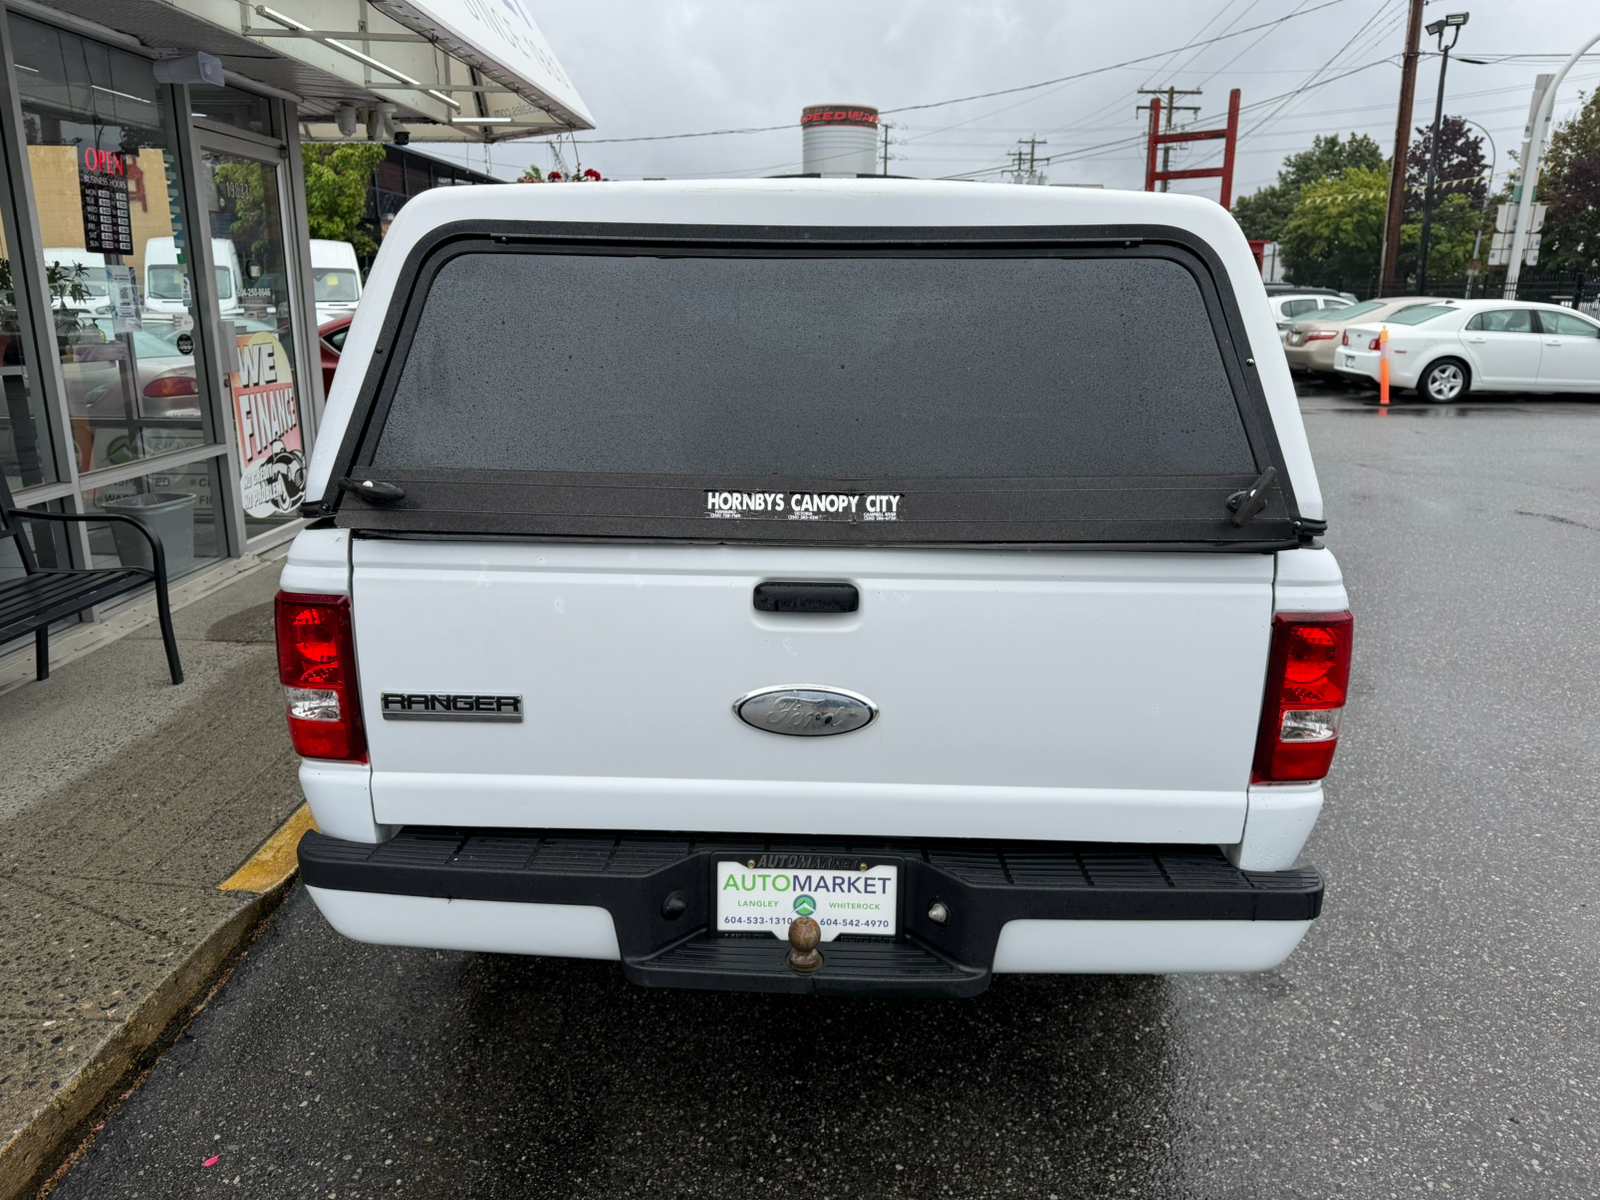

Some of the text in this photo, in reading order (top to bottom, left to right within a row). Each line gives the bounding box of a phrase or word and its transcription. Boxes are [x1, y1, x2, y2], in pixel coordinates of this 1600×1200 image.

[85, 147, 125, 177] OPEN
[83, 174, 127, 189] BUSINESS HOURS
[226, 181, 250, 200] 19833
[237, 343, 278, 388] WE
[238, 387, 297, 462] FINANCE
[243, 472, 252, 490] NO
[707, 492, 900, 513] HORNBYS CANOPY CITY
[382, 694, 521, 712] RANGER
[766, 696, 845, 727] Ford
[757, 854, 861, 870] AUTOMARKET
[723, 874, 892, 894] AUTOMARKET
[828, 902, 881, 910] WHITEROCK
[724, 916, 889, 928] 604-533-1310 604-542-4970
